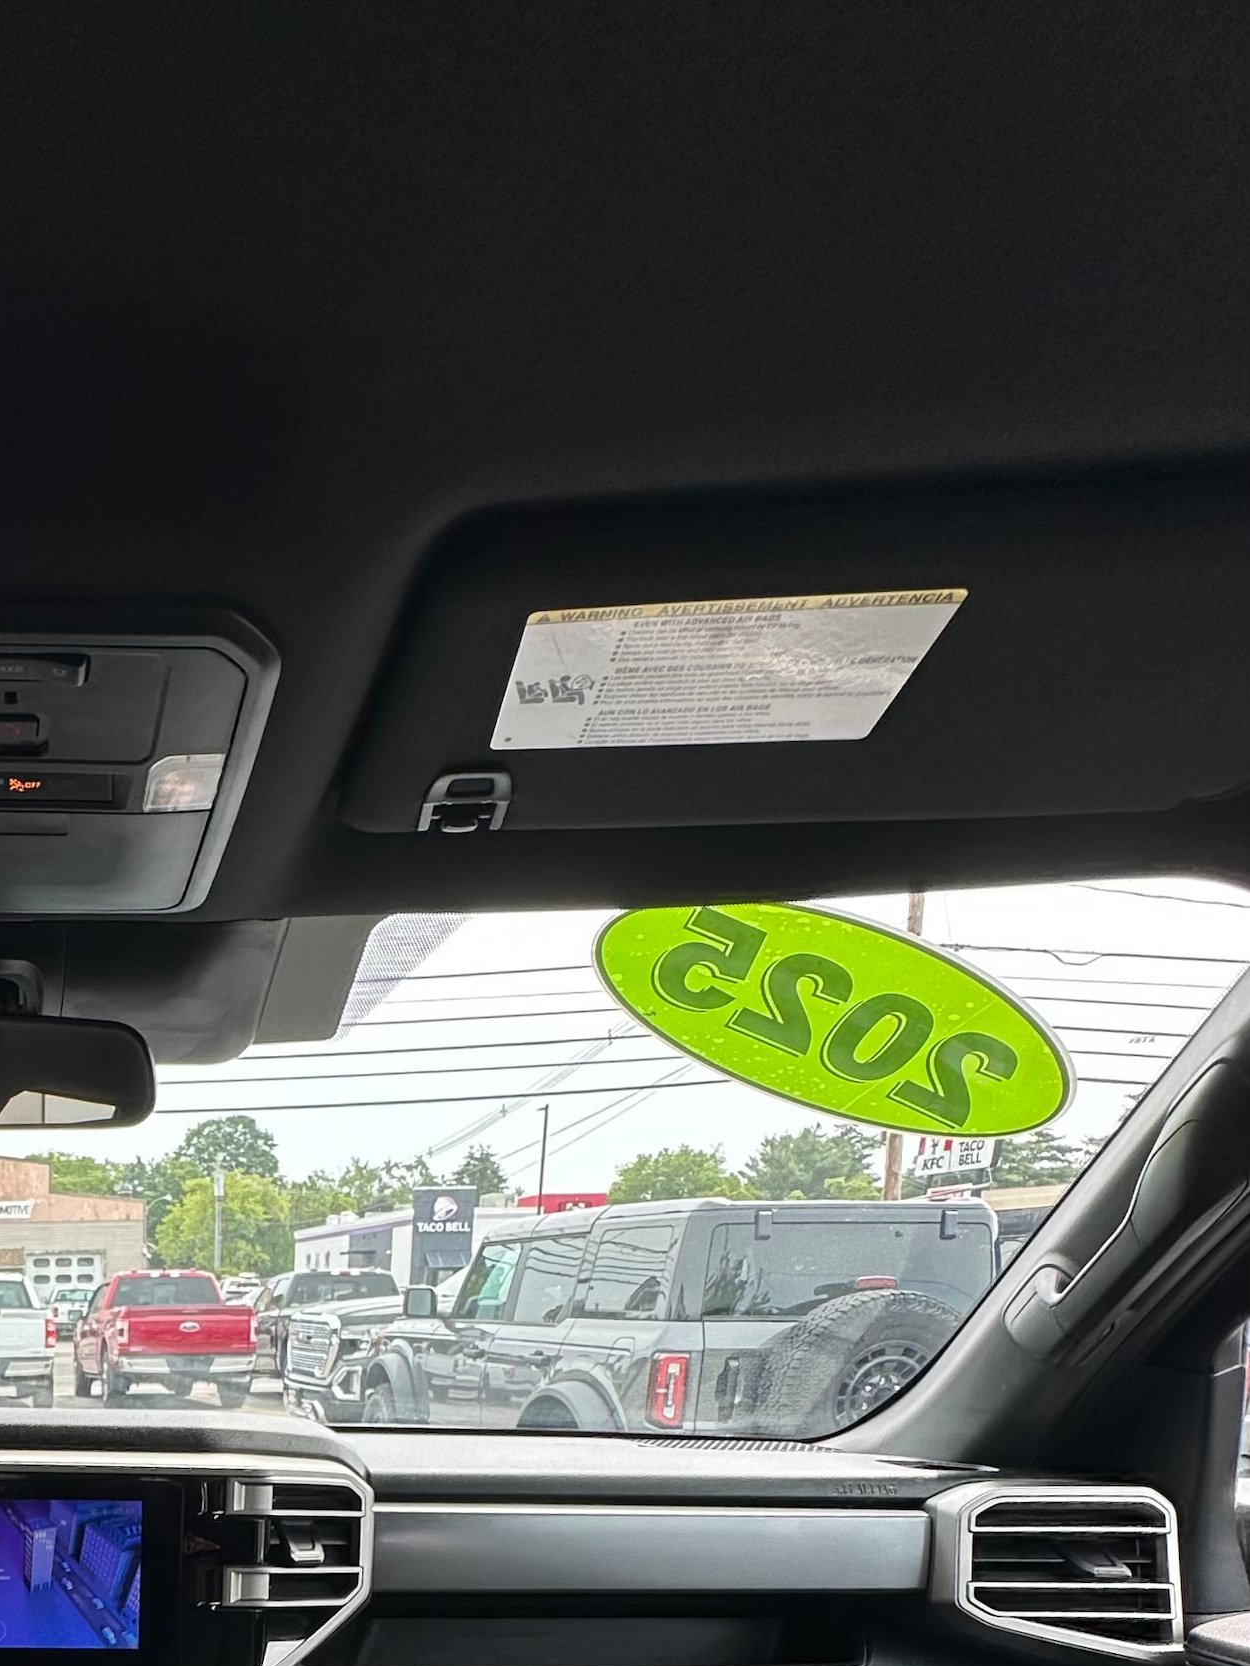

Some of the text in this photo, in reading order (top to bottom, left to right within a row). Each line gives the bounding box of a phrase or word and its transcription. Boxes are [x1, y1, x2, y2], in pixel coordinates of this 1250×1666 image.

[561, 592, 955, 622] WARNING AVERTISSEMENT ADVERTENCIA
[633, 619, 658, 628] EVEN
[684, 615, 735, 626] ADVANCED
[754, 613, 782, 623] BAGS
[687, 662, 733, 672] COUSSINS
[651, 706, 696, 715] AVANZADO
[25, 781, 41, 790] OFF
[958, 1140, 985, 1153] TACO
[922, 1152, 982, 1170] KFC BELL
[416, 1222, 471, 1233] TACO BELL
